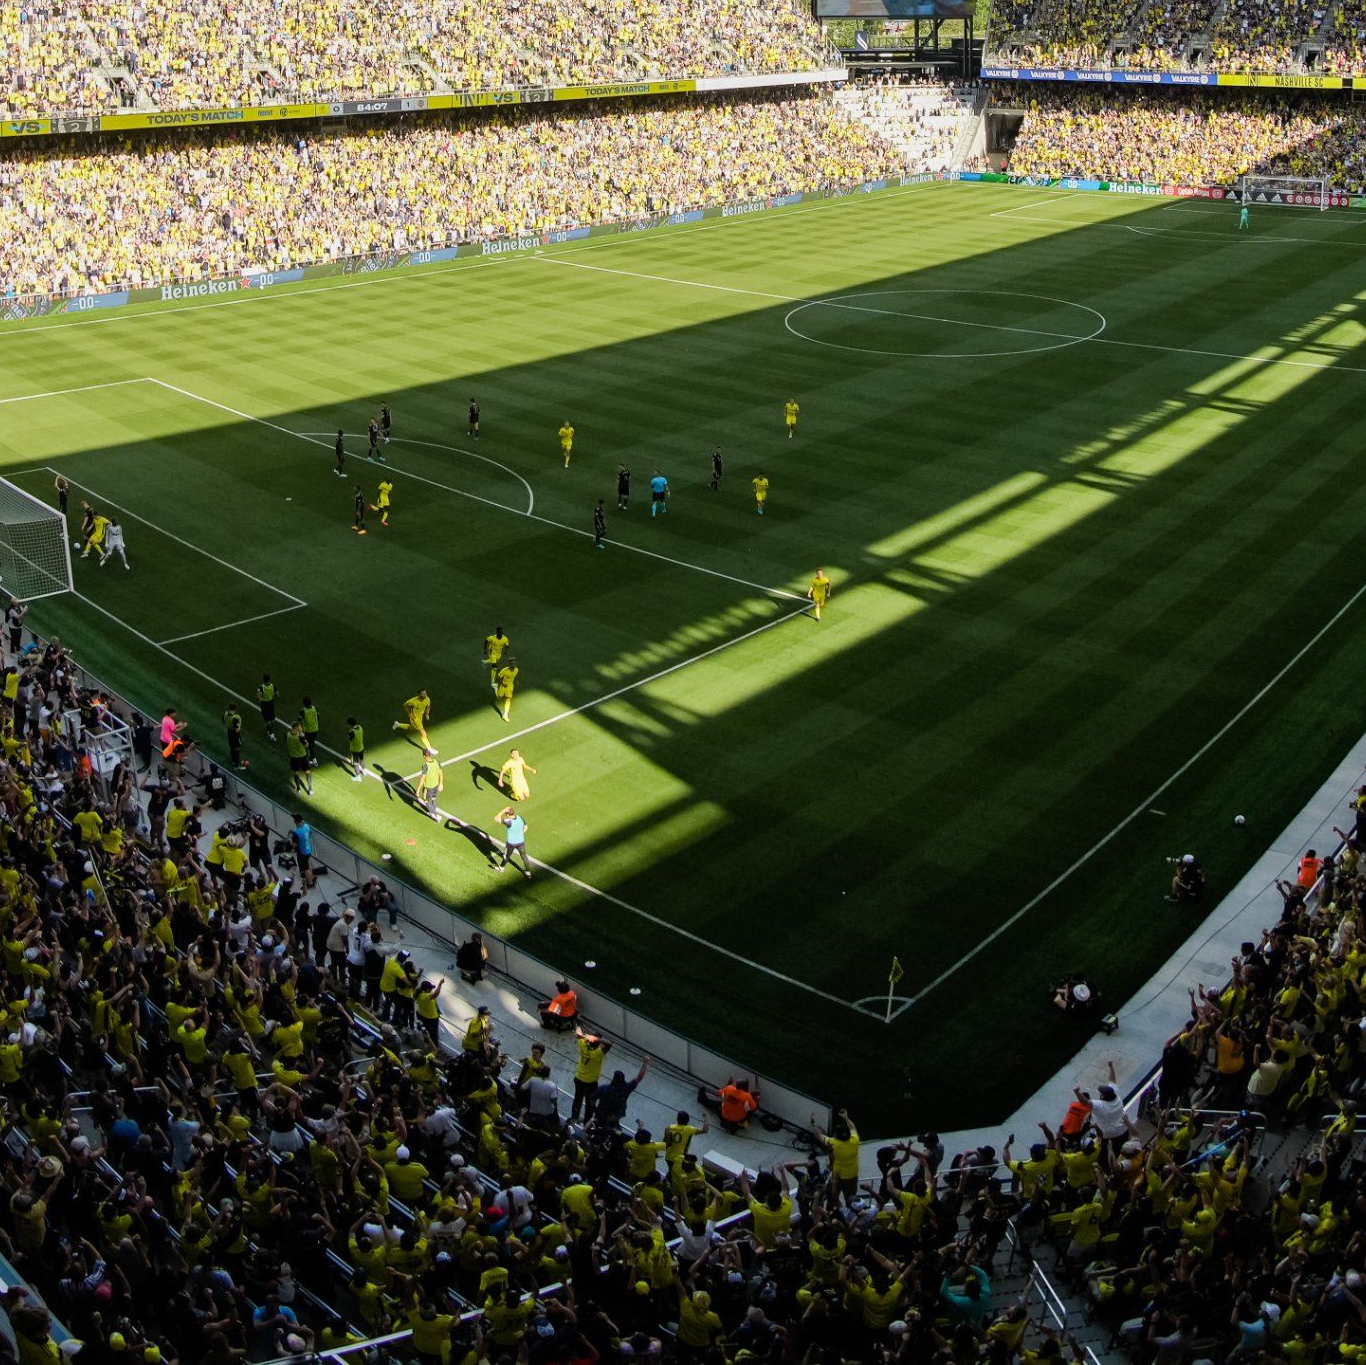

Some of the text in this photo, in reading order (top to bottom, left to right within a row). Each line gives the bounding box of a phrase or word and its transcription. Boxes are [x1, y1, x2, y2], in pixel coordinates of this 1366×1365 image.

[985, 69, 1011, 78] VALKYRIE
[1030, 71, 1057, 79] VALKYRIE
[1076, 72, 1104, 80] VALKYRIE
[1124, 74, 1153, 82] VALKYRIE
[1171, 75, 1200, 84] VALKYRIE
[1275, 77, 1324, 88] NASHVILLE SC
[585, 87, 620, 96] TODAY'S
[621, 85, 650, 94] MATCH
[356, 102, 388, 112] 84:07
[147, 111, 199, 125] TODAY'S
[201, 110, 244, 122] MATCH
[11, 121, 40, 134] VS
[899, 174, 934, 186] Heineken
[1109, 182, 1162, 195] Heineken
[722, 200, 765, 217] Heineken
[483, 237, 540, 255] Heineken
[161, 280, 237, 301] Heineken
